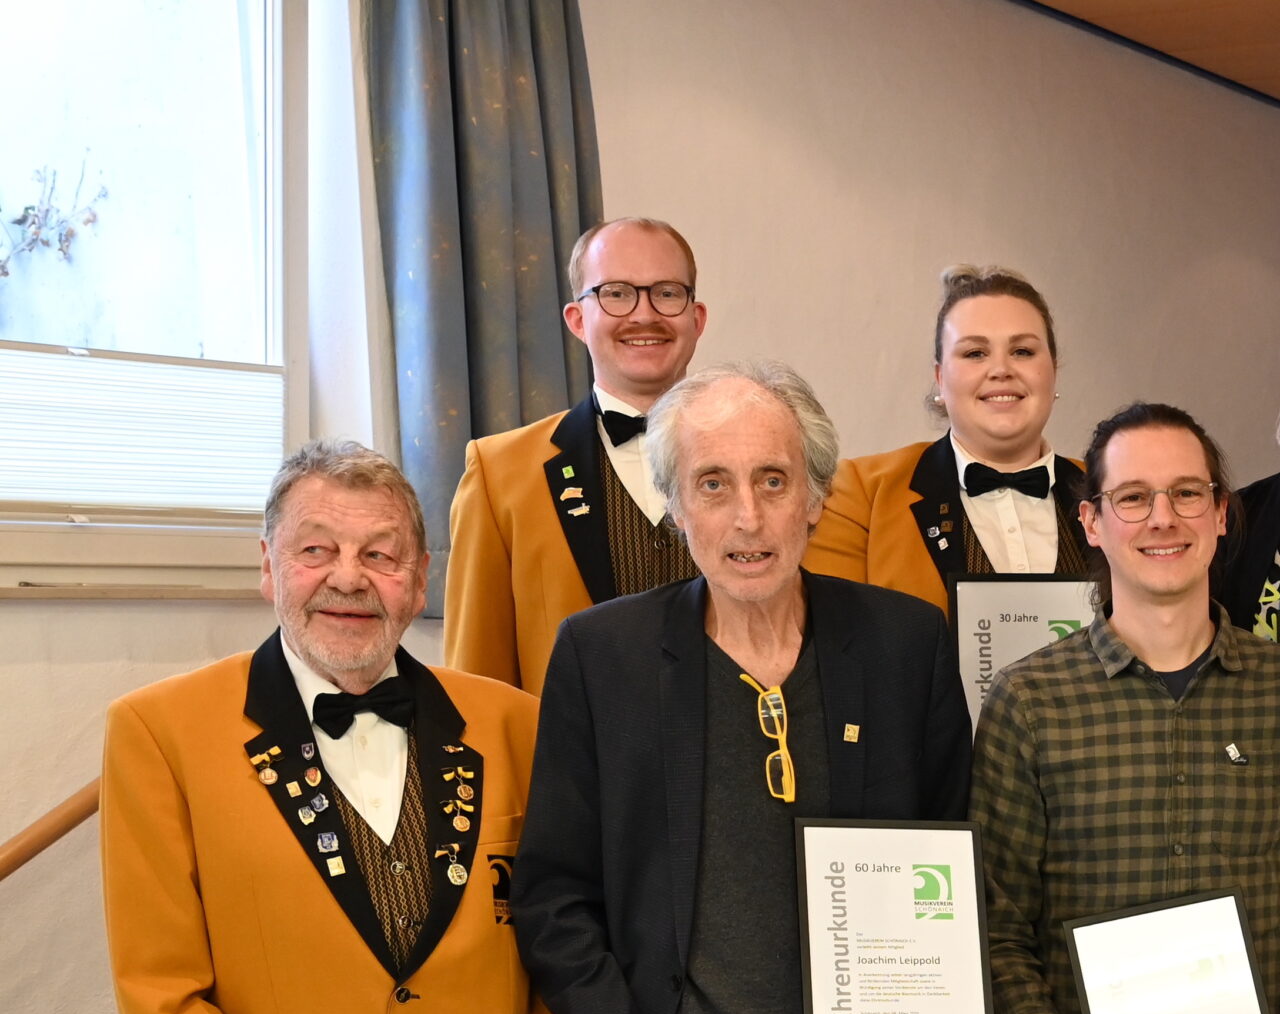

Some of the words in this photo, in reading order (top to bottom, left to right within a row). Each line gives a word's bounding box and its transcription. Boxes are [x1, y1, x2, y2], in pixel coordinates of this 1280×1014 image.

[999, 613, 1011, 622] 30
[1012, 613, 1039, 622] Jahre
[974, 618, 993, 700] rkunde
[855, 863, 869, 873] 60
[871, 863, 901, 873] Jahre
[857, 956, 897, 965] Joachim
[899, 956, 941, 967] Leippold
